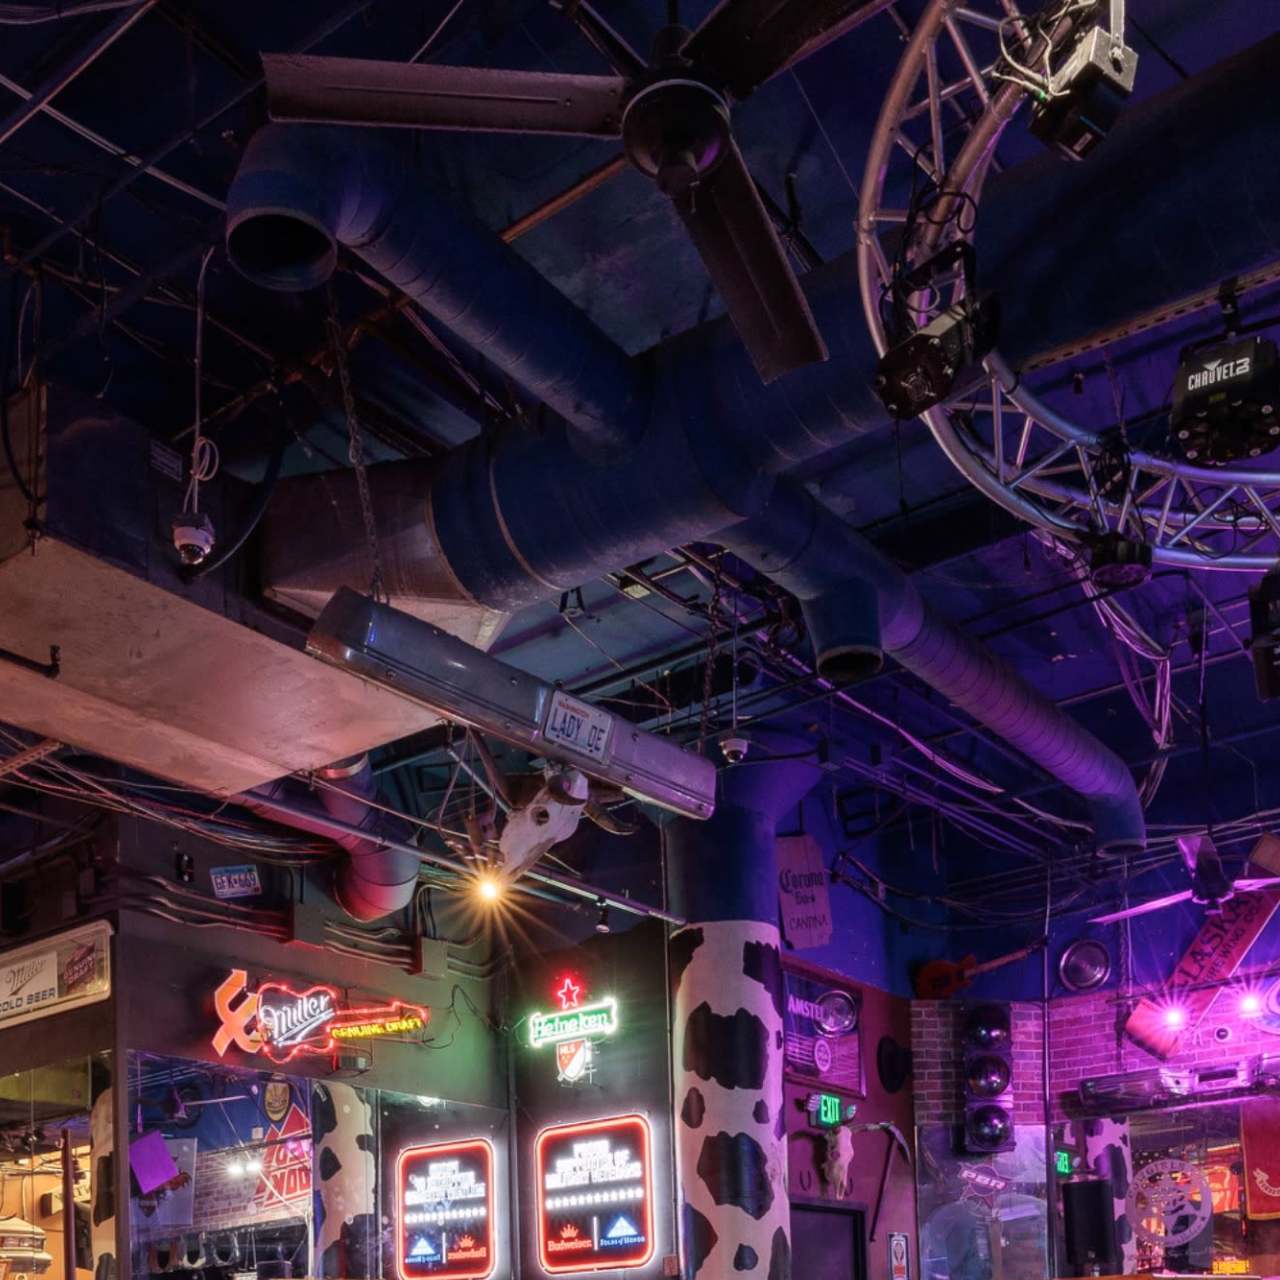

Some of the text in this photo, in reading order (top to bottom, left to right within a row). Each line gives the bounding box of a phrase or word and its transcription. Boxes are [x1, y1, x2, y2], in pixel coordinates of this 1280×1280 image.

[1187, 361, 1237, 391] CHAUVET
[550, 707, 584, 741] LADY
[779, 868, 824, 894] Corona
[26, 987, 56, 1005] BEER
[260, 994, 332, 1041] Miller
[535, 1011, 611, 1039] Heineken
[821, 1094, 840, 1123] EXIT
